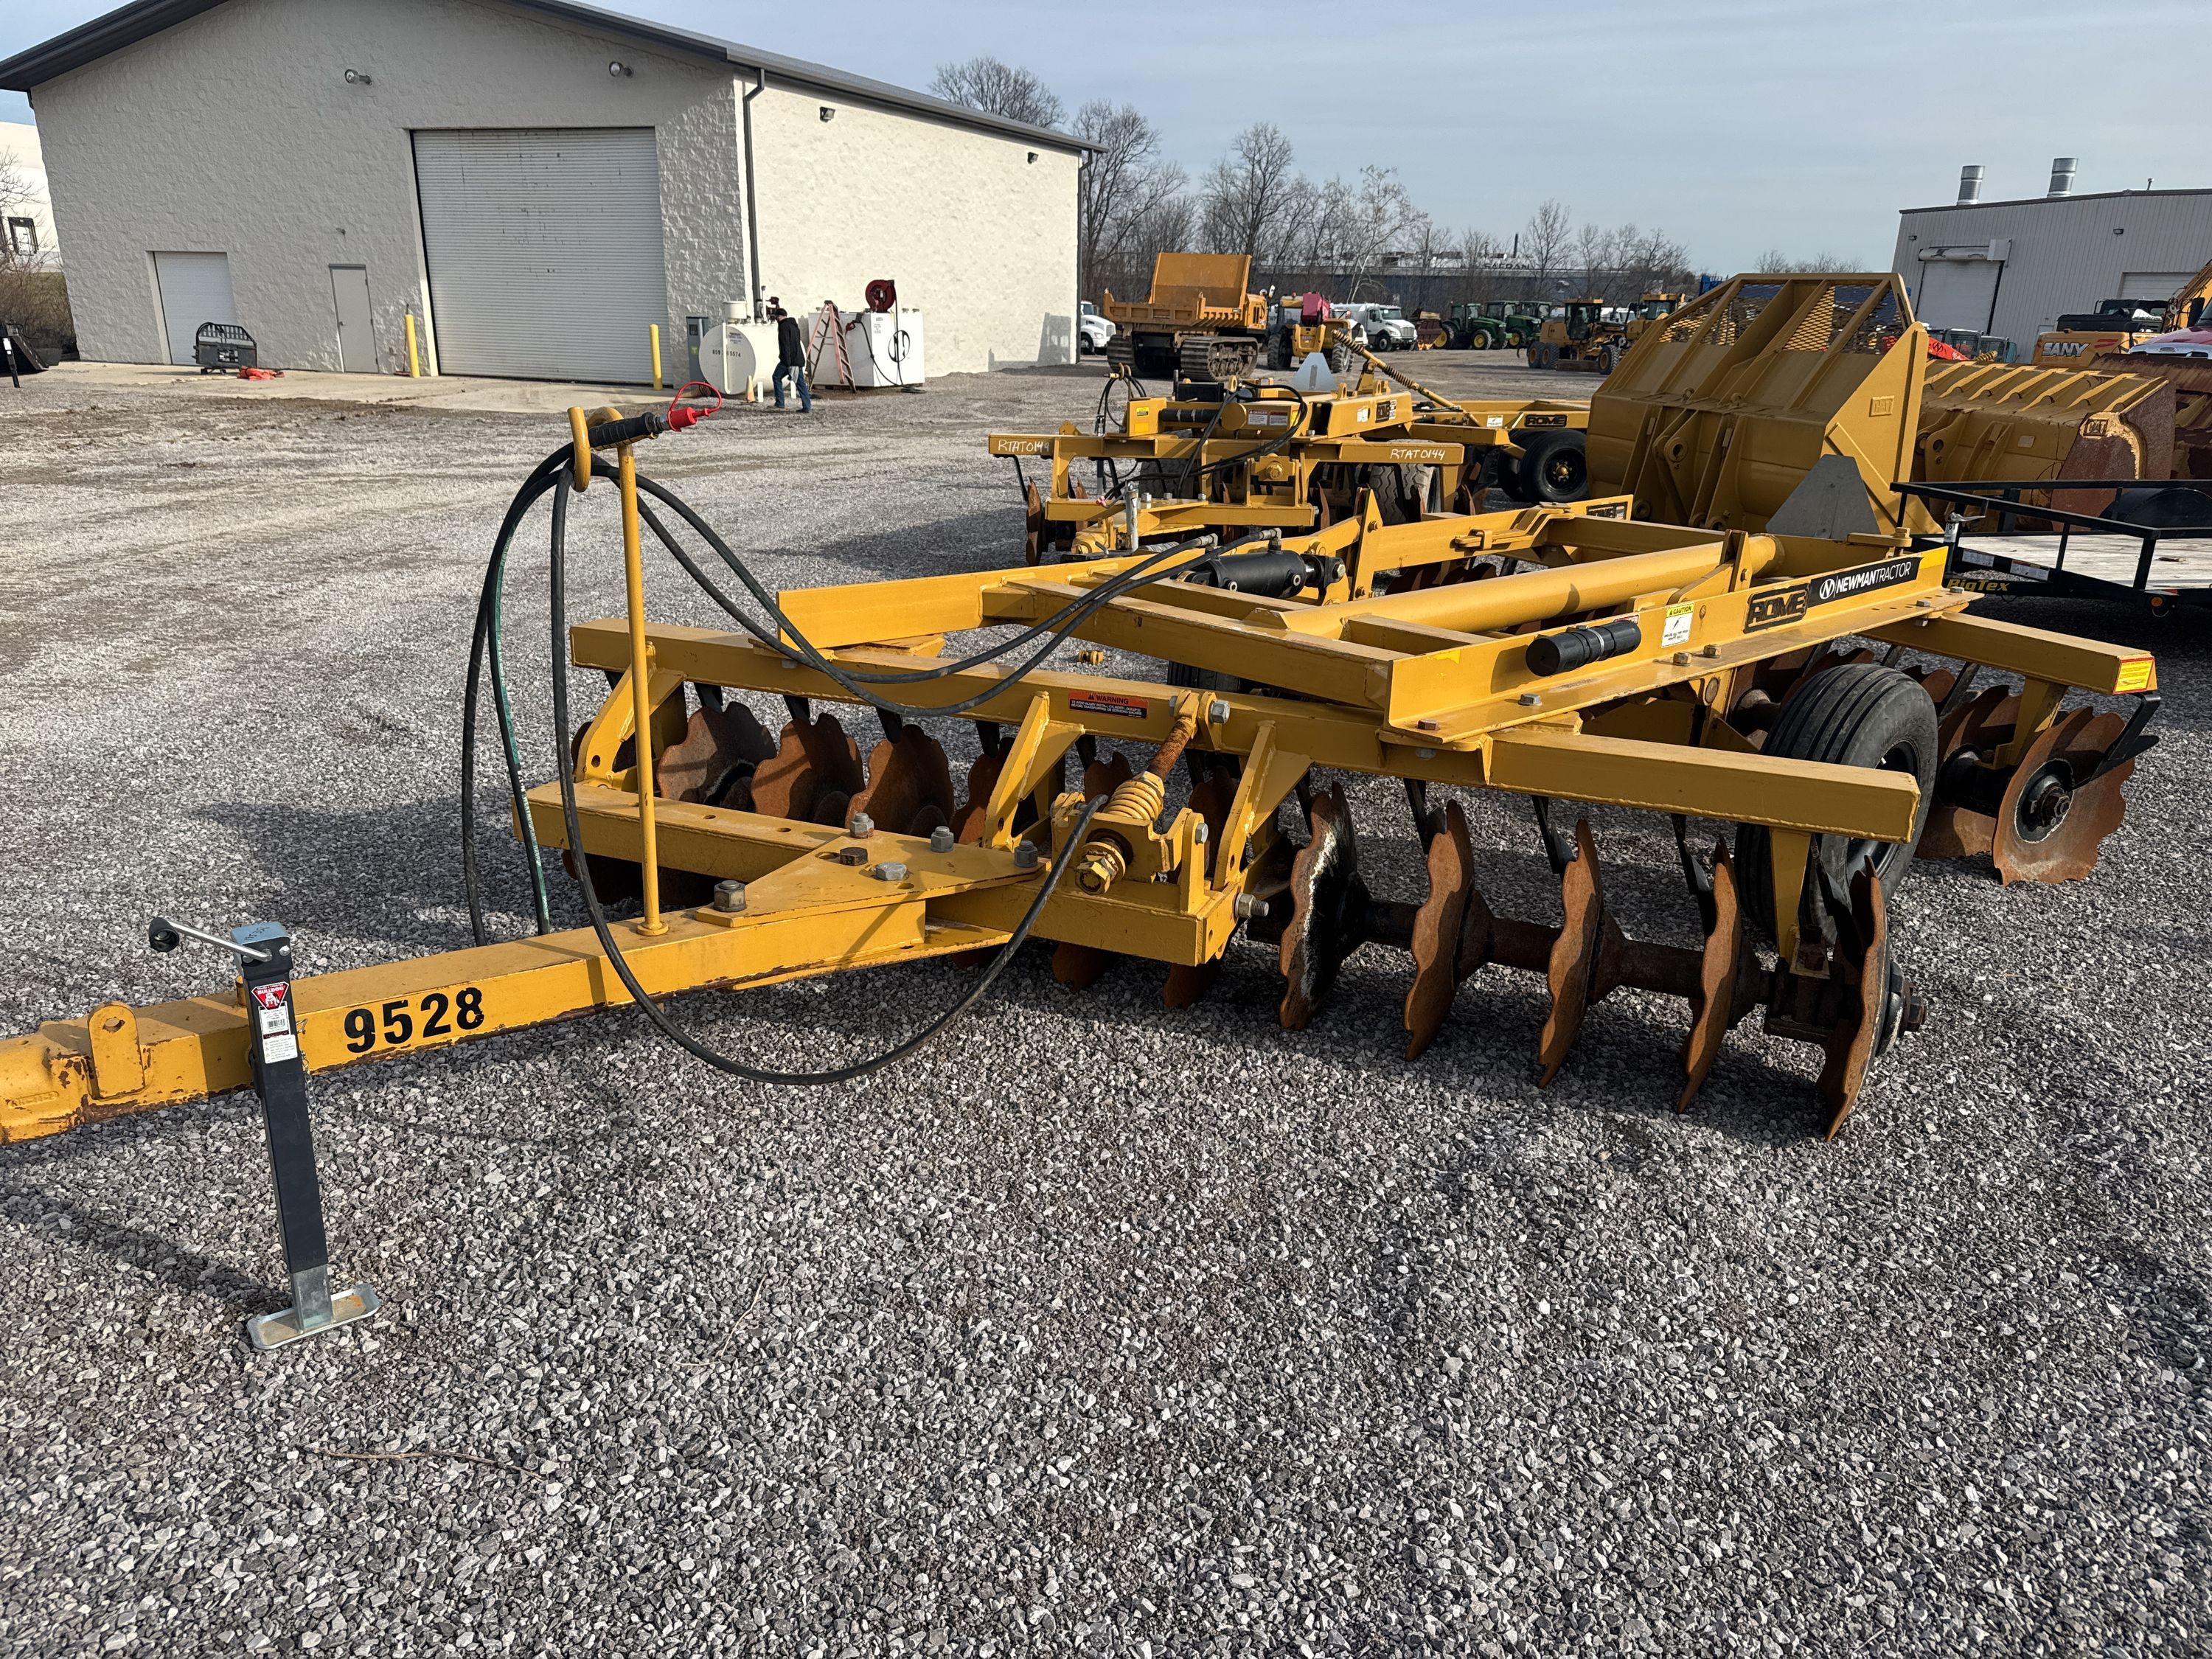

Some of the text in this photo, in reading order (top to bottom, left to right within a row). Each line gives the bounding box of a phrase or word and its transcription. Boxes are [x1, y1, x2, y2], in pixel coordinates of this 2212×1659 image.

[2042, 341, 2090, 357] SANY
[1673, 605, 1692, 615] CAUTION
[1748, 592, 1806, 624] ROME
[1096, 695, 1129, 705] WARNING
[257, 986, 285, 995] BULLDOG
[344, 987, 485, 1054] 9528
